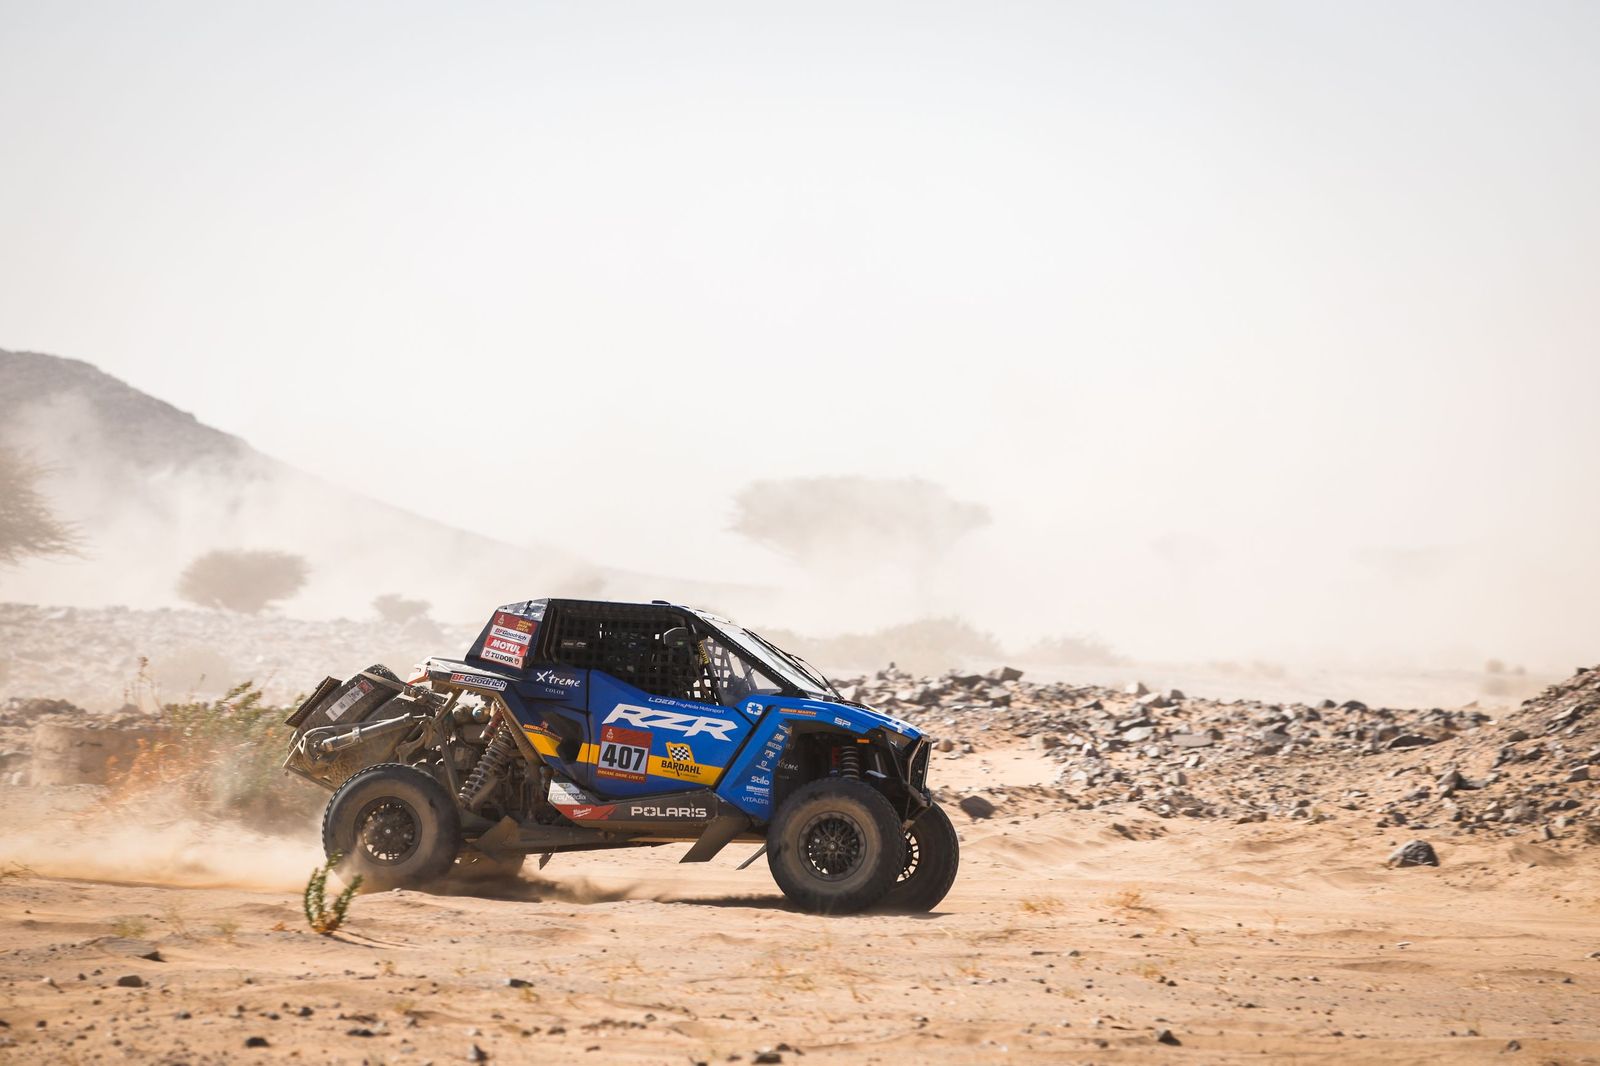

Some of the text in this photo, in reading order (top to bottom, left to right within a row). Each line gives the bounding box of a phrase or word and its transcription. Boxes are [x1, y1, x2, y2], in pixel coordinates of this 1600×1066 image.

[495, 627, 527, 640] BFGoodrich
[491, 639, 521, 654] MOTUL
[491, 651, 514, 663] TUDOR
[451, 674, 507, 689] BFGoodrich
[545, 687, 565, 695] COLOR
[602, 703, 738, 741] RZR
[602, 744, 645, 771] 407
[661, 760, 701, 774] BARDAHL
[631, 806, 707, 818] POLARIS
